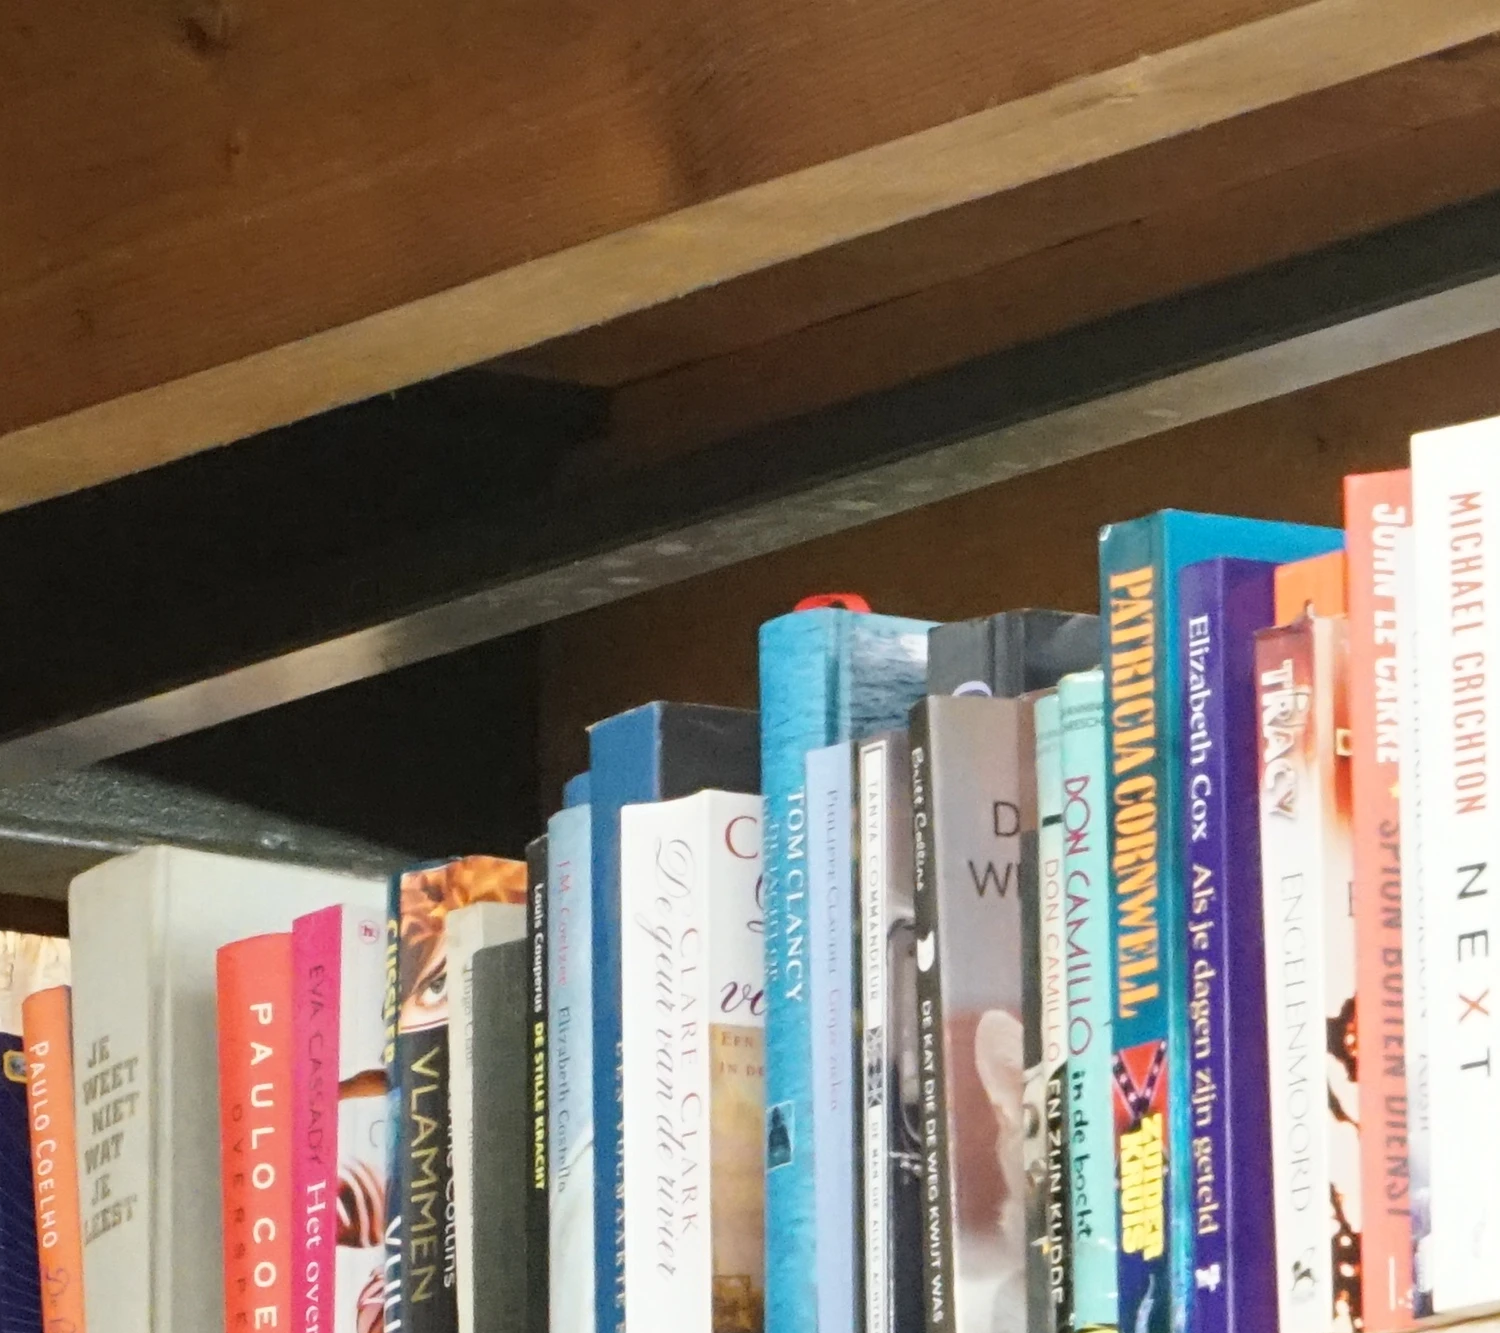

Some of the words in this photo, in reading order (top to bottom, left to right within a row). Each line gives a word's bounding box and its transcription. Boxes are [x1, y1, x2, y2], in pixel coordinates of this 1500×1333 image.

[1448, 491, 1485, 640] MICHAEL
[1108, 566, 1156, 770] PATRICIA
[1187, 614, 1211, 767] Elizabeth
[1451, 652, 1489, 816] CRICHTON
[787, 786, 803, 849] TOM
[868, 781, 880, 843] TANYA
[1189, 776, 1209, 843] Cox
[533, 882, 545, 924] Louis
[1112, 776, 1161, 1019] CORNWELL
[1191, 863, 1210, 913] Als
[786, 854, 806, 1001] CLANCY
[1191, 920, 1210, 954] je
[532, 927, 545, 1012] Couperus
[1456, 863, 1491, 1076] NEXT
[535, 1022, 545, 1051] DE
[1190, 960, 1215, 1060] dagen
[28, 1041, 51, 1129] PAULO
[82, 1058, 140, 1106] WEET
[88, 1035, 110, 1066] JE
[92, 1091, 141, 1138] NIET
[249, 1002, 275, 1191] PAULO
[533, 1054, 546, 1121] STILLE
[1190, 1066, 1217, 1129] zijn
[84, 1131, 124, 1176] WAT
[409, 1045, 438, 1303] VLAMMEN
[533, 1125, 546, 1190] KRACHT
[1191, 1136, 1219, 1235] geteld
[35, 1133, 56, 1249] COELHO
[91, 1175, 112, 1208] JE
[304, 1179, 328, 1250] Het
